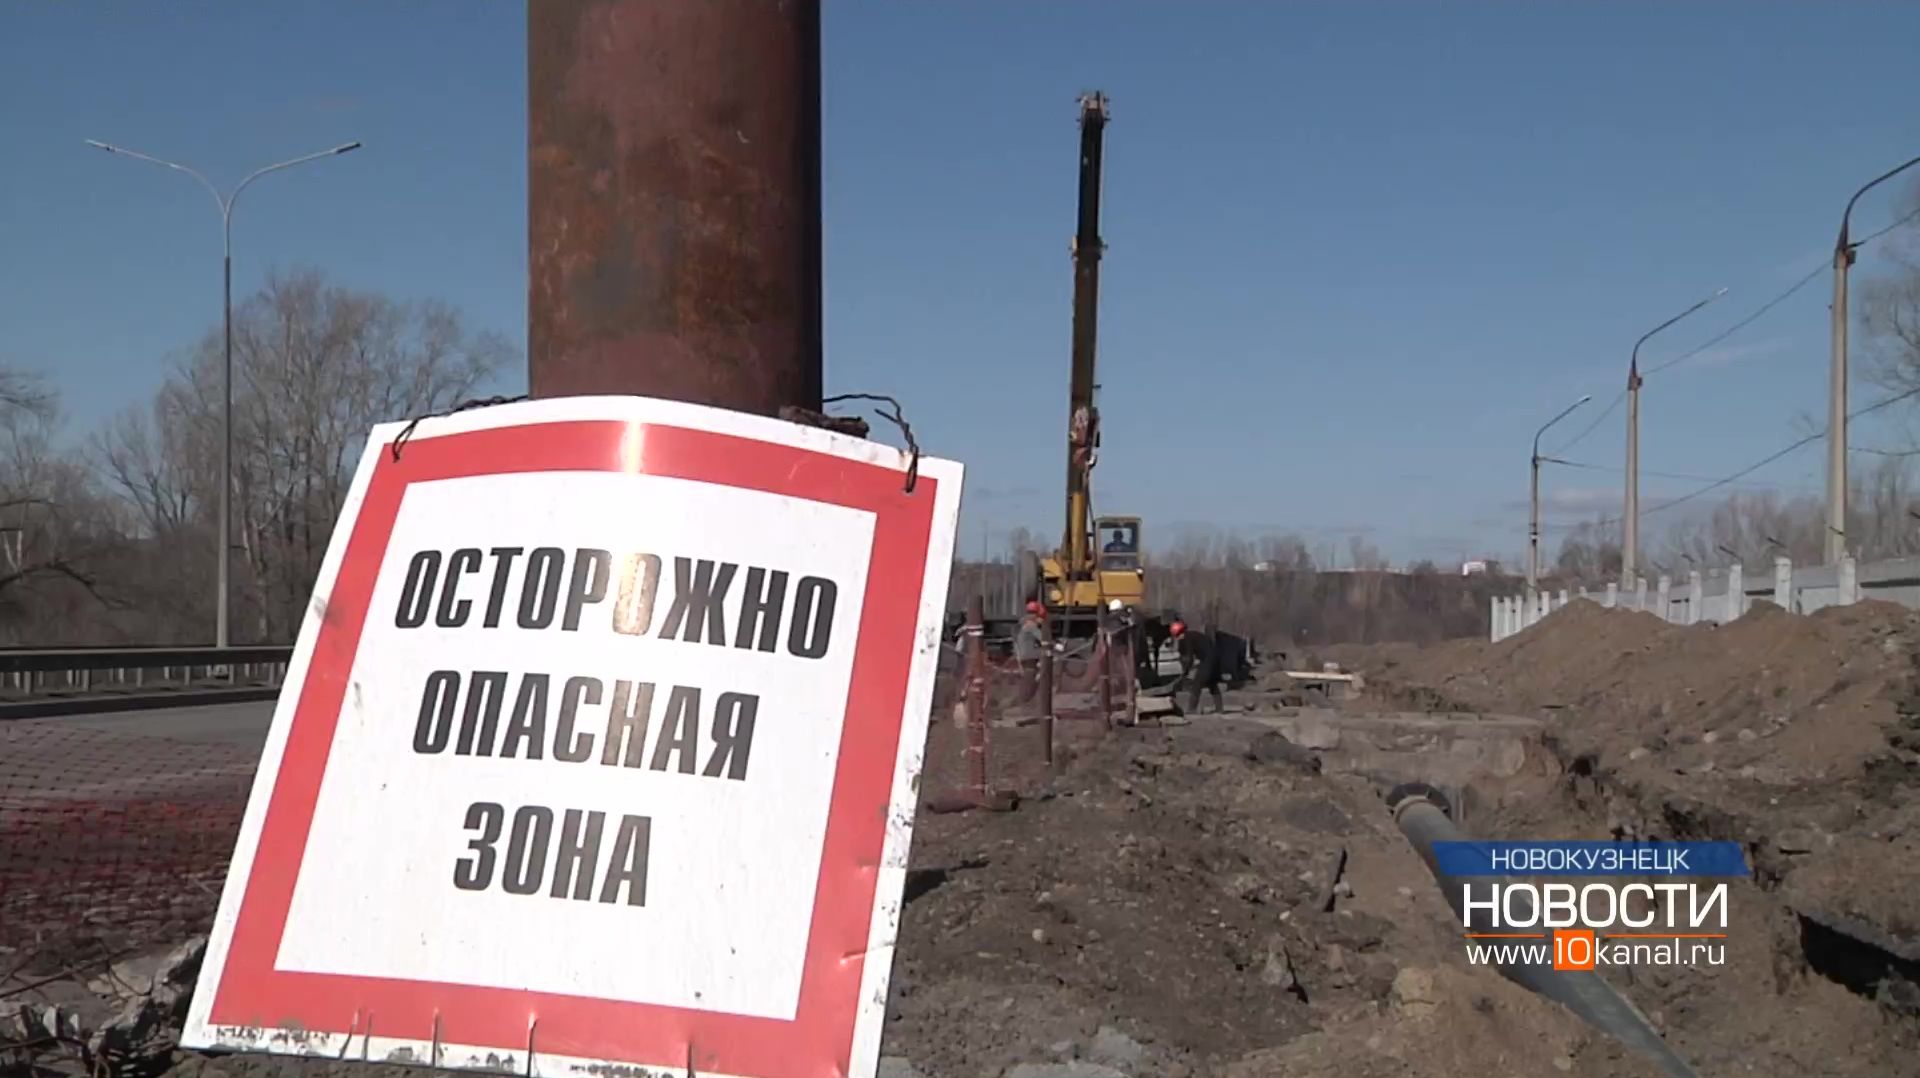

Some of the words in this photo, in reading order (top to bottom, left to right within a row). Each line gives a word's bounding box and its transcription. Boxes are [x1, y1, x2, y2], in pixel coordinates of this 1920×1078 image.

[395, 547, 838, 659] ОСТОРОЖНО
[413, 670, 760, 781] ОПАСНАЯ
[453, 802, 652, 907] ЗОНА
